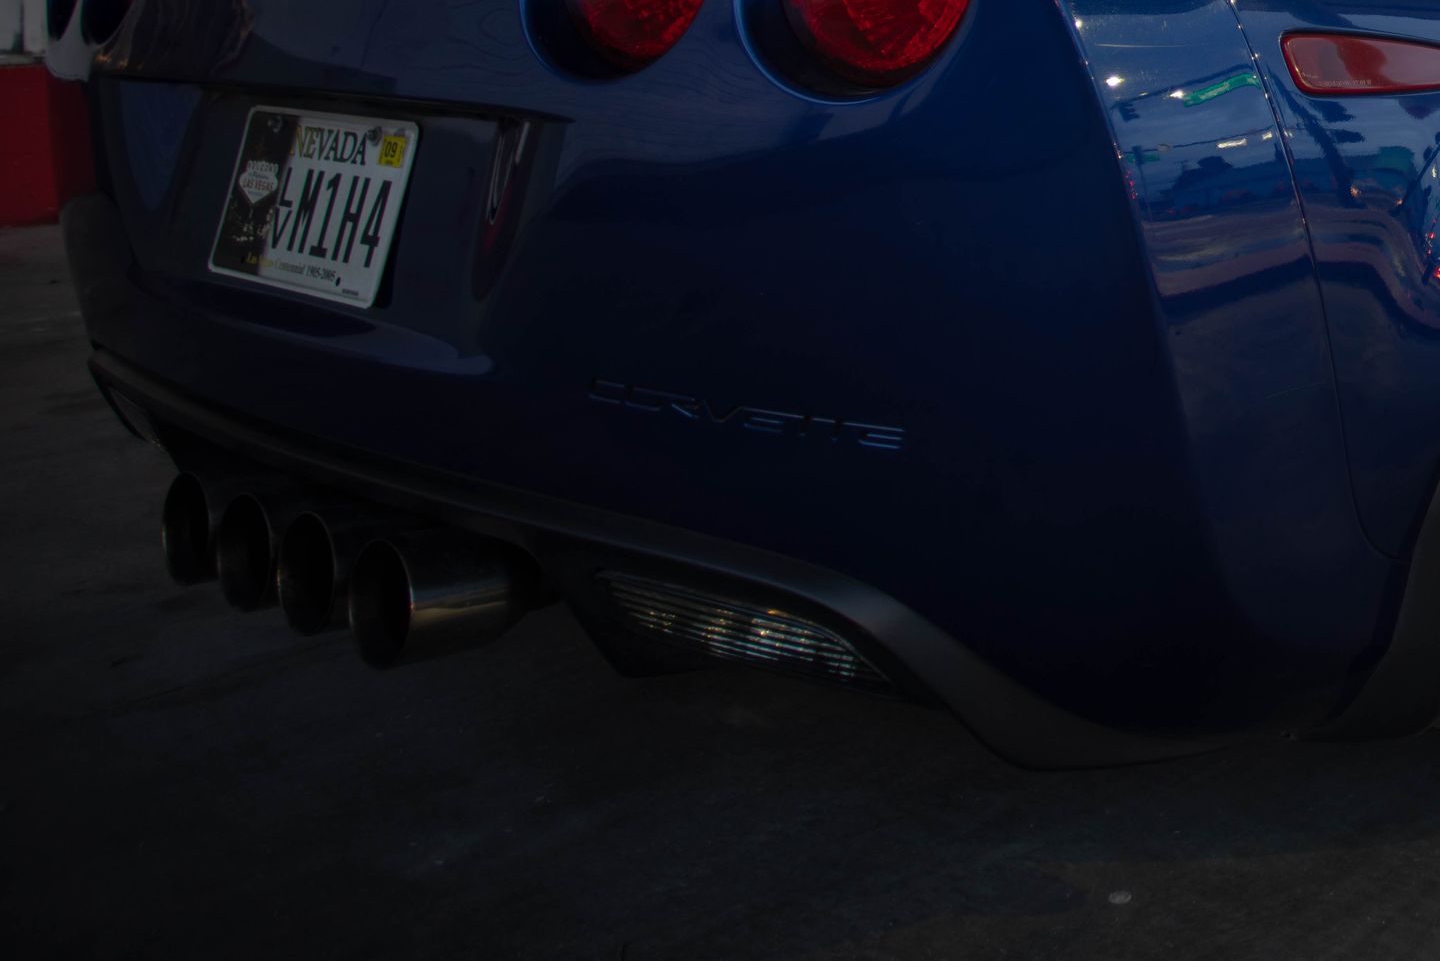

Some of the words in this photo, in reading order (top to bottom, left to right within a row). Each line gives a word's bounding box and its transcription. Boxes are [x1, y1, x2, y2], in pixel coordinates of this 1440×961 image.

[290, 126, 367, 166] NEVADA
[384, 141, 398, 158] 09
[588, 376, 906, 450] CORVETTE
